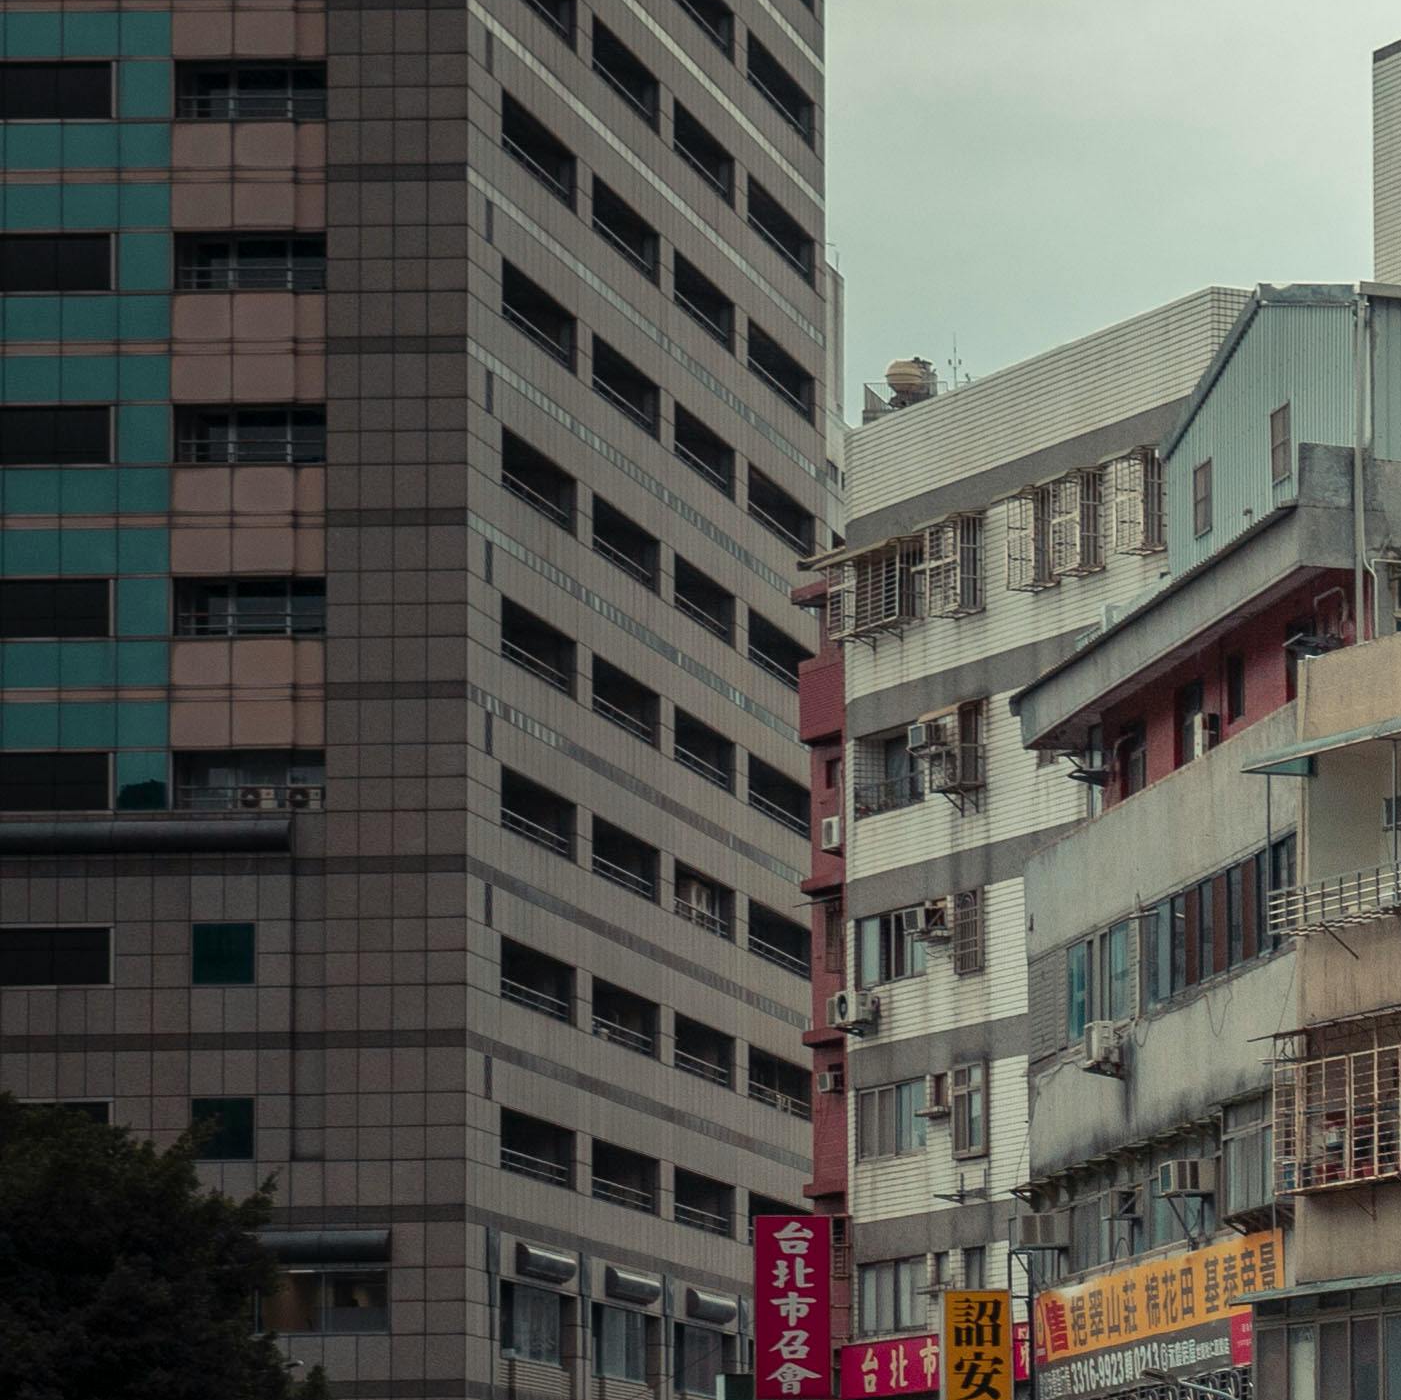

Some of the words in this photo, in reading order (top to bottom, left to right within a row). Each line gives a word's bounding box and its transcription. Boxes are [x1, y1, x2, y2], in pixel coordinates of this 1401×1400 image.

[766, 1221, 822, 1395] 台北市召會
[1045, 1300, 1069, 1353] 售
[1146, 1267, 1195, 1329] 棉花田
